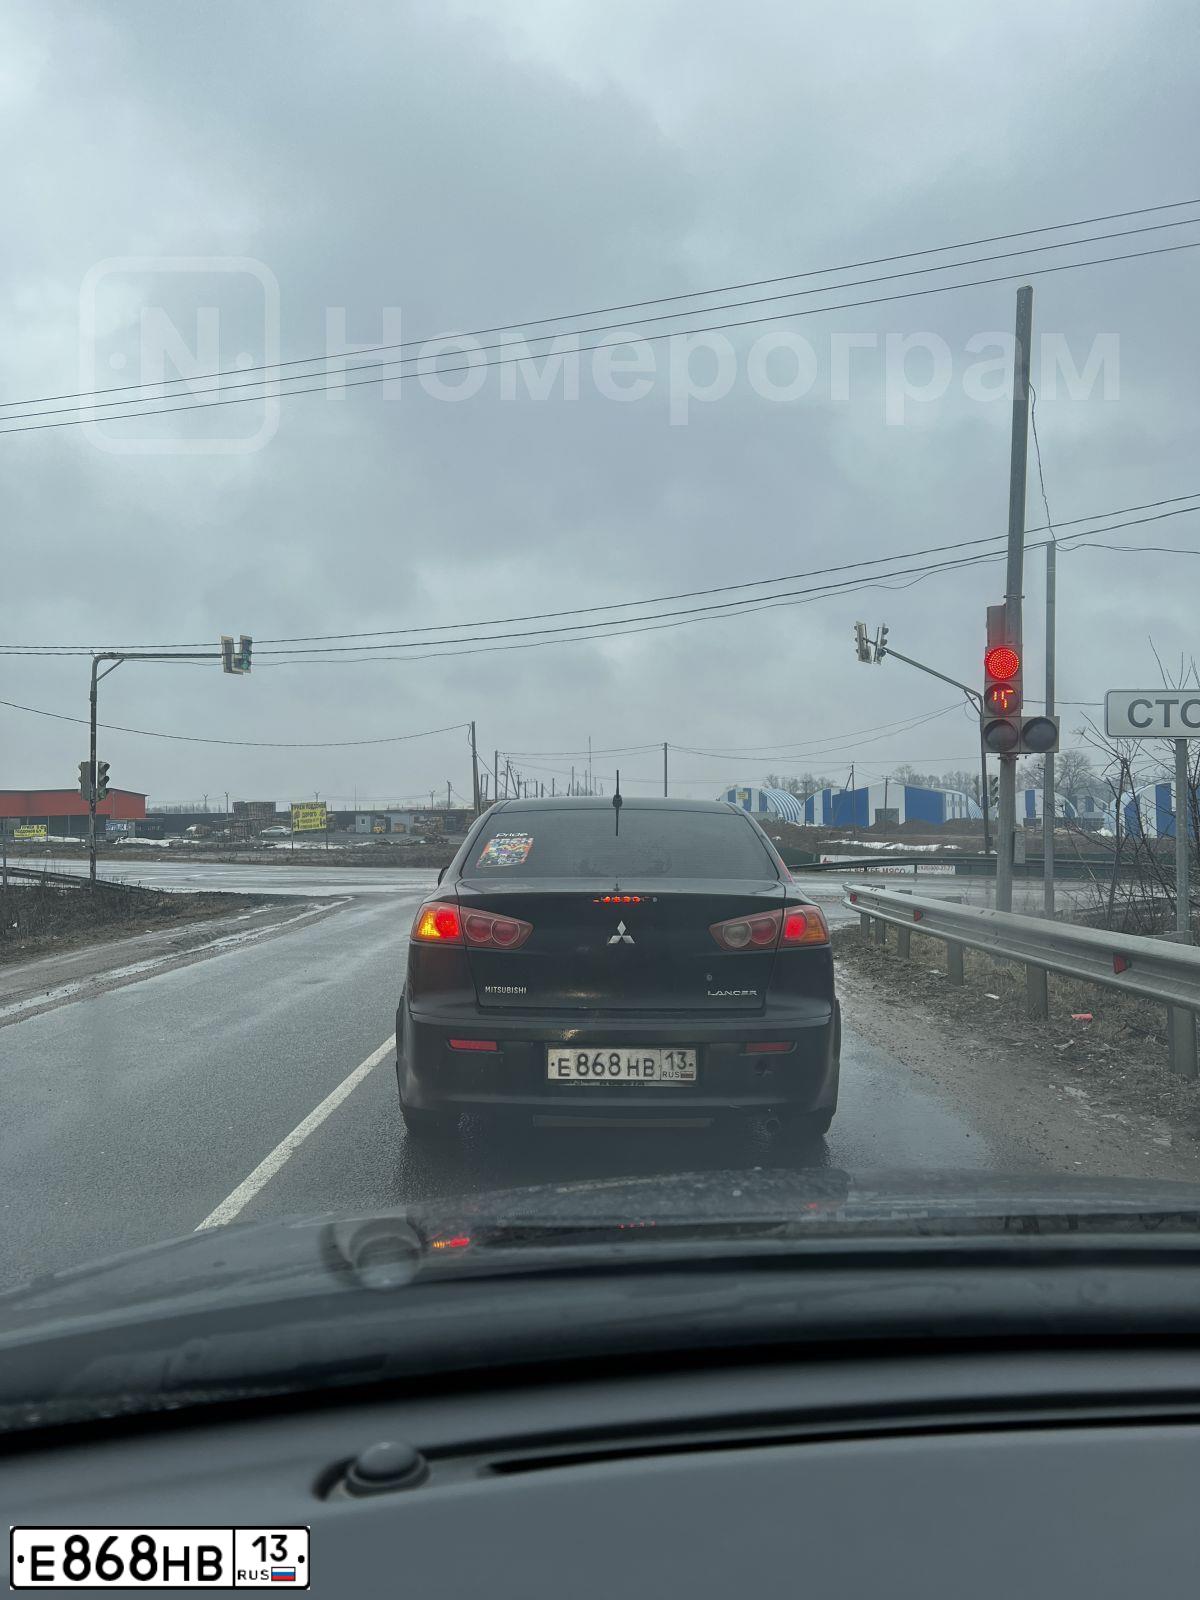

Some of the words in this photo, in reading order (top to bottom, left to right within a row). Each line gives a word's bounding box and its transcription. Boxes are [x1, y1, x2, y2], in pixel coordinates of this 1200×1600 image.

[485, 985, 527, 994] MITSUBISHI
[558, 1052, 655, 1077] Е868НВ
[665, 1051, 688, 1070] 13
